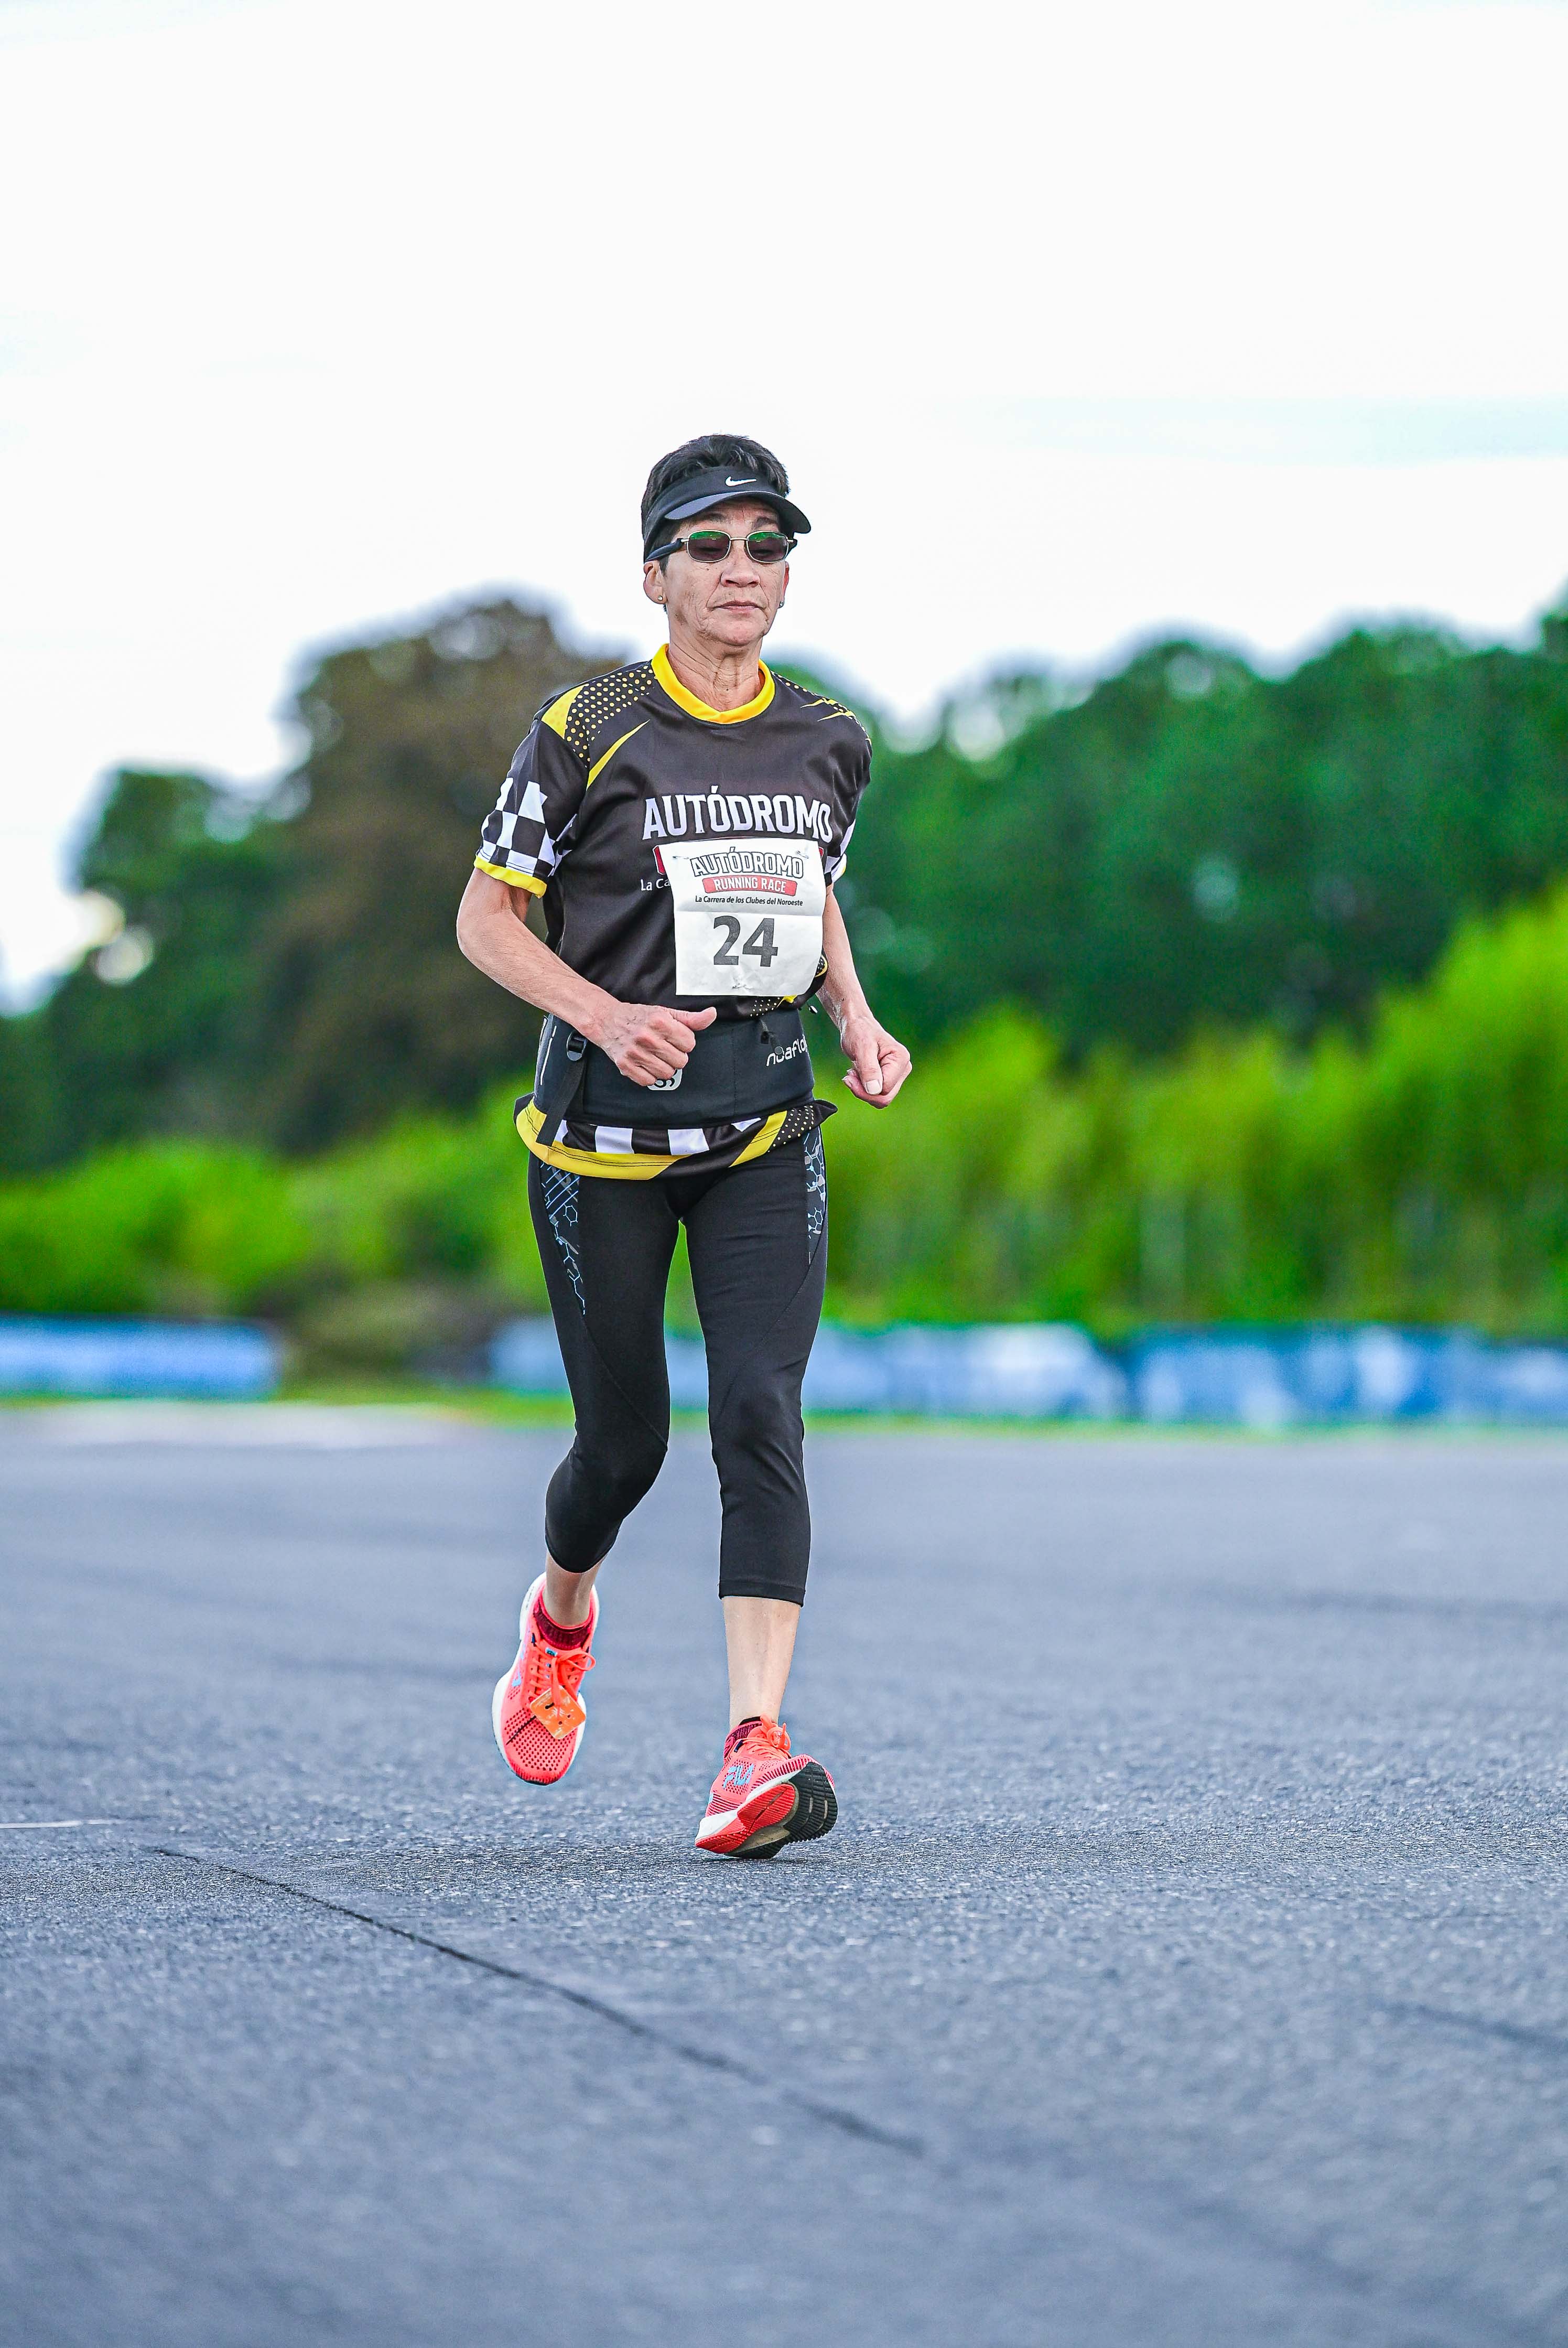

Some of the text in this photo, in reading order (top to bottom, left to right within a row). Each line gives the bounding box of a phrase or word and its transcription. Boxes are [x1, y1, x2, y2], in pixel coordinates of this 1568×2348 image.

[642, 785, 834, 844] AUTÓDROMO
[690, 847, 804, 879] AUTÓDROMO
[640, 879, 652, 891] La
[713, 877, 786, 893] RUNNING RACE
[713, 915, 778, 967] 24
[723, 1763, 754, 1789] FILA
